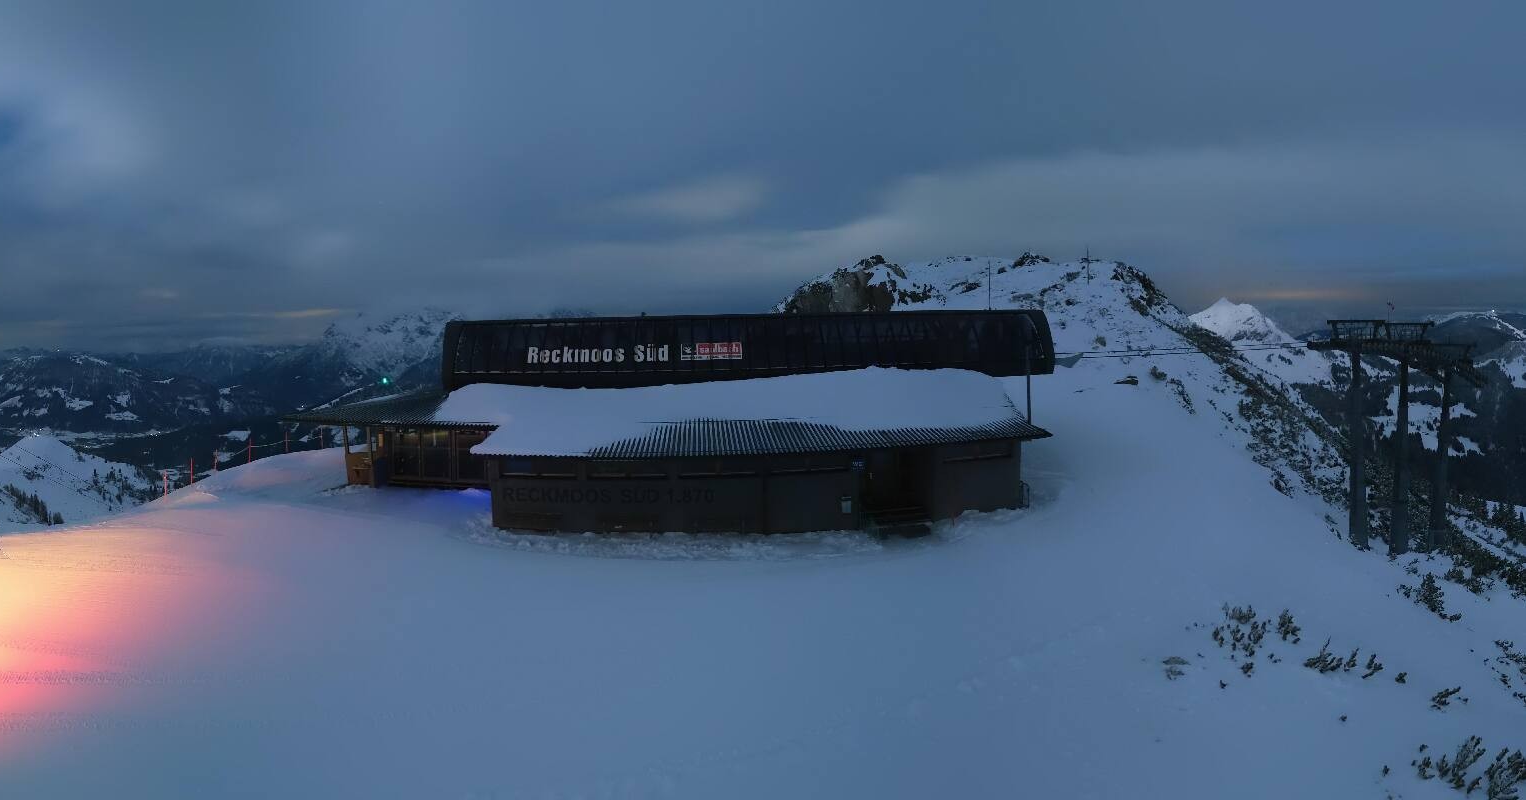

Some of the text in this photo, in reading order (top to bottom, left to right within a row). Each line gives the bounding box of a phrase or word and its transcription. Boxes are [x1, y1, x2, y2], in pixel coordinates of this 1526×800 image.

[526, 344, 669, 364] Reckmoos Süd
[503, 487, 612, 505] RECKMOOS
[666, 487, 716, 505] 1.870
